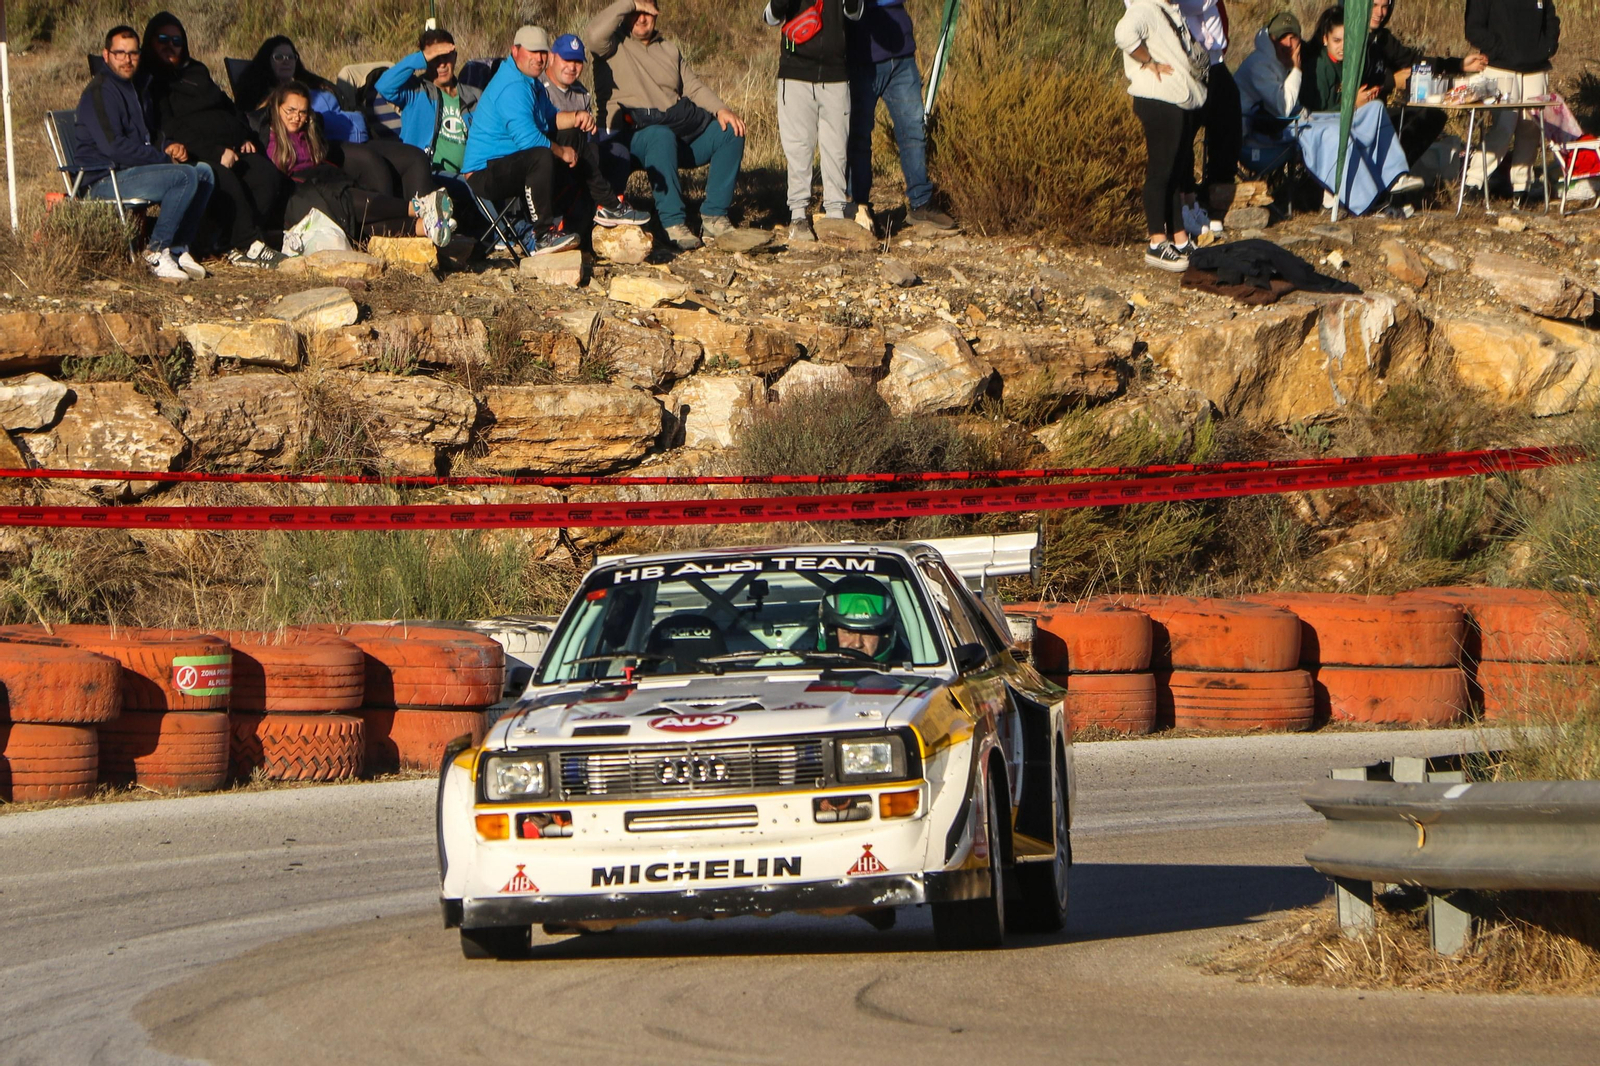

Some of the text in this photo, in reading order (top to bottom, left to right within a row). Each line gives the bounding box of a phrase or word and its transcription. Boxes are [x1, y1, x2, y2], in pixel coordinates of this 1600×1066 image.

[614, 566, 665, 585] HB
[771, 557, 876, 572] TEAM
[591, 856, 802, 888] MICHELIN
[857, 857, 880, 872] HB
[508, 876, 531, 892] HB
